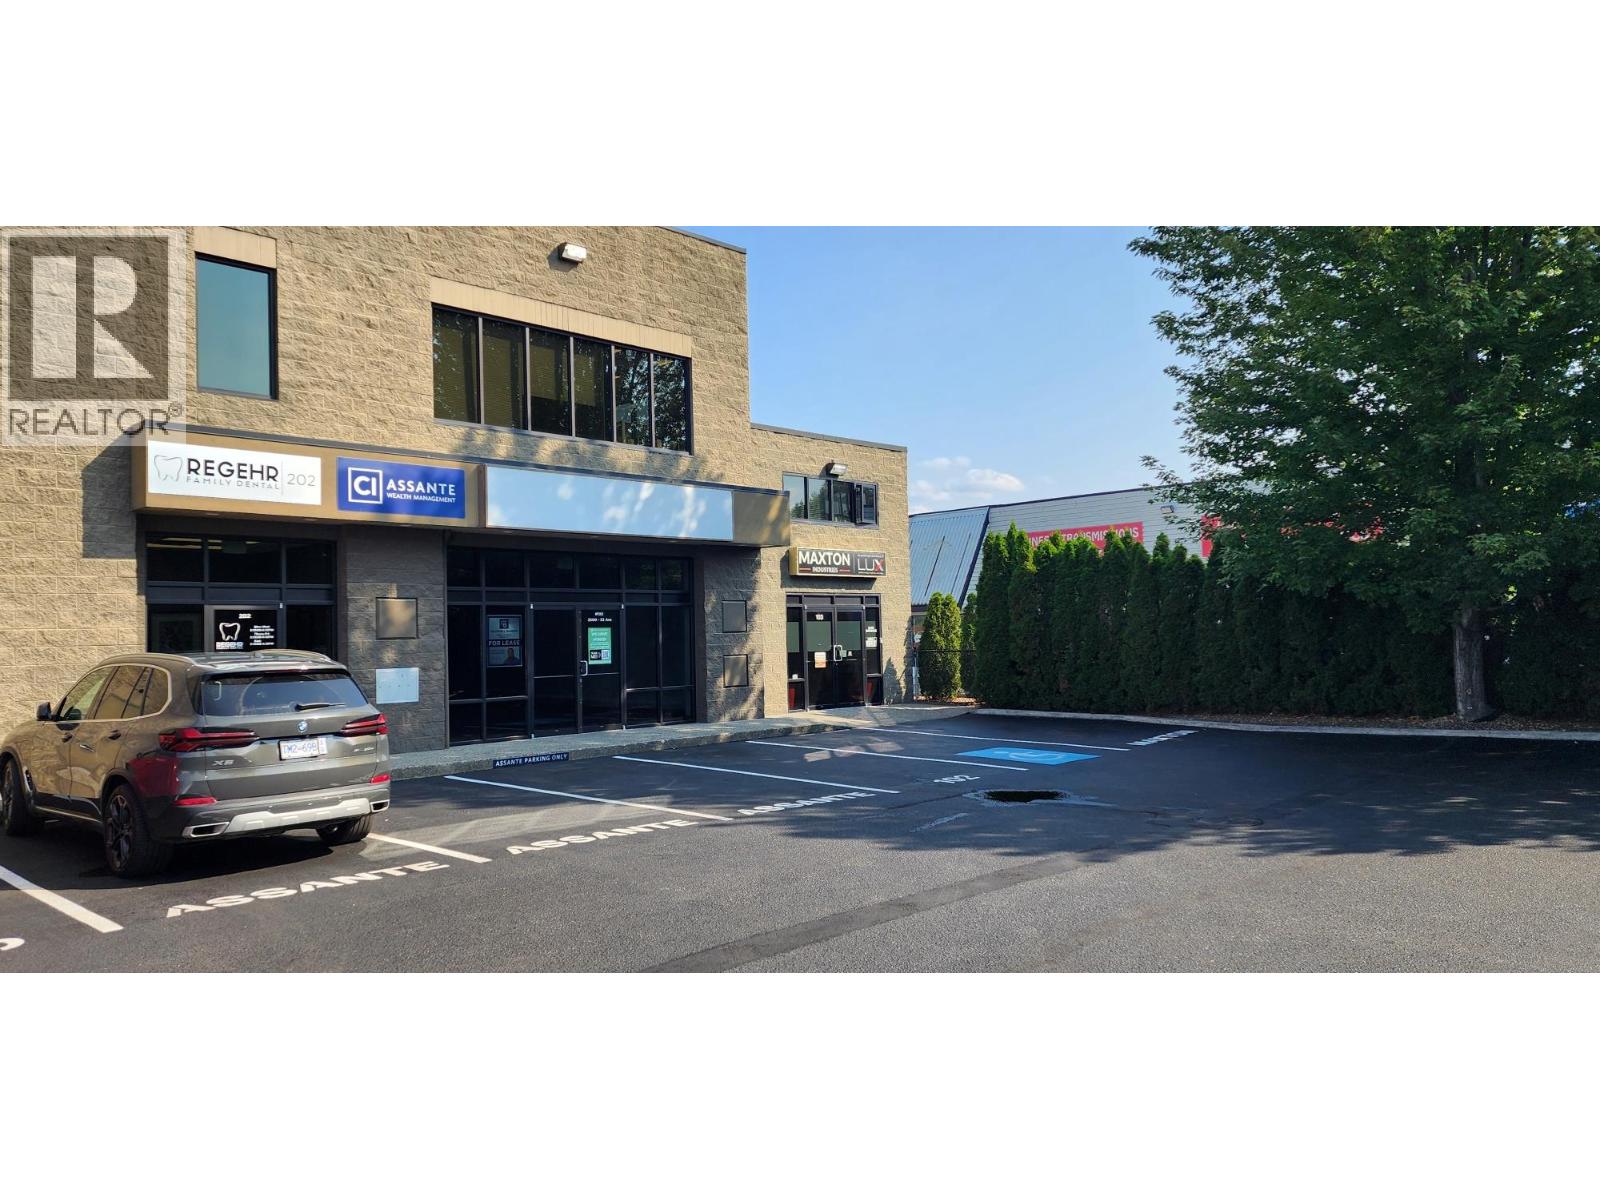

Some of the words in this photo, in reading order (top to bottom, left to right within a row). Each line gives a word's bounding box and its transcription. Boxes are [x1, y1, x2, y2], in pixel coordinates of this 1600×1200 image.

[187, 458, 279, 482] REGEHR
[186, 476, 232, 486] FAMILY
[236, 480, 280, 490] DENTAL
[287, 473, 316, 487] 202
[353, 475, 377, 496] CI
[386, 479, 456, 496] ASSANTE
[386, 492, 412, 500] WEALTH
[413, 494, 456, 503] MANAGEMENT
[799, 551, 850, 566] MAXTON
[857, 558, 884, 571] LUX
[495, 758, 522, 767] ASSANTE
[524, 755, 551, 763] PARKING
[551, 752, 568, 760] ONLY
[737, 791, 876, 815] ASSANTE
[506, 819, 699, 854] ASSANTE
[166, 861, 450, 918] ASSANTE
